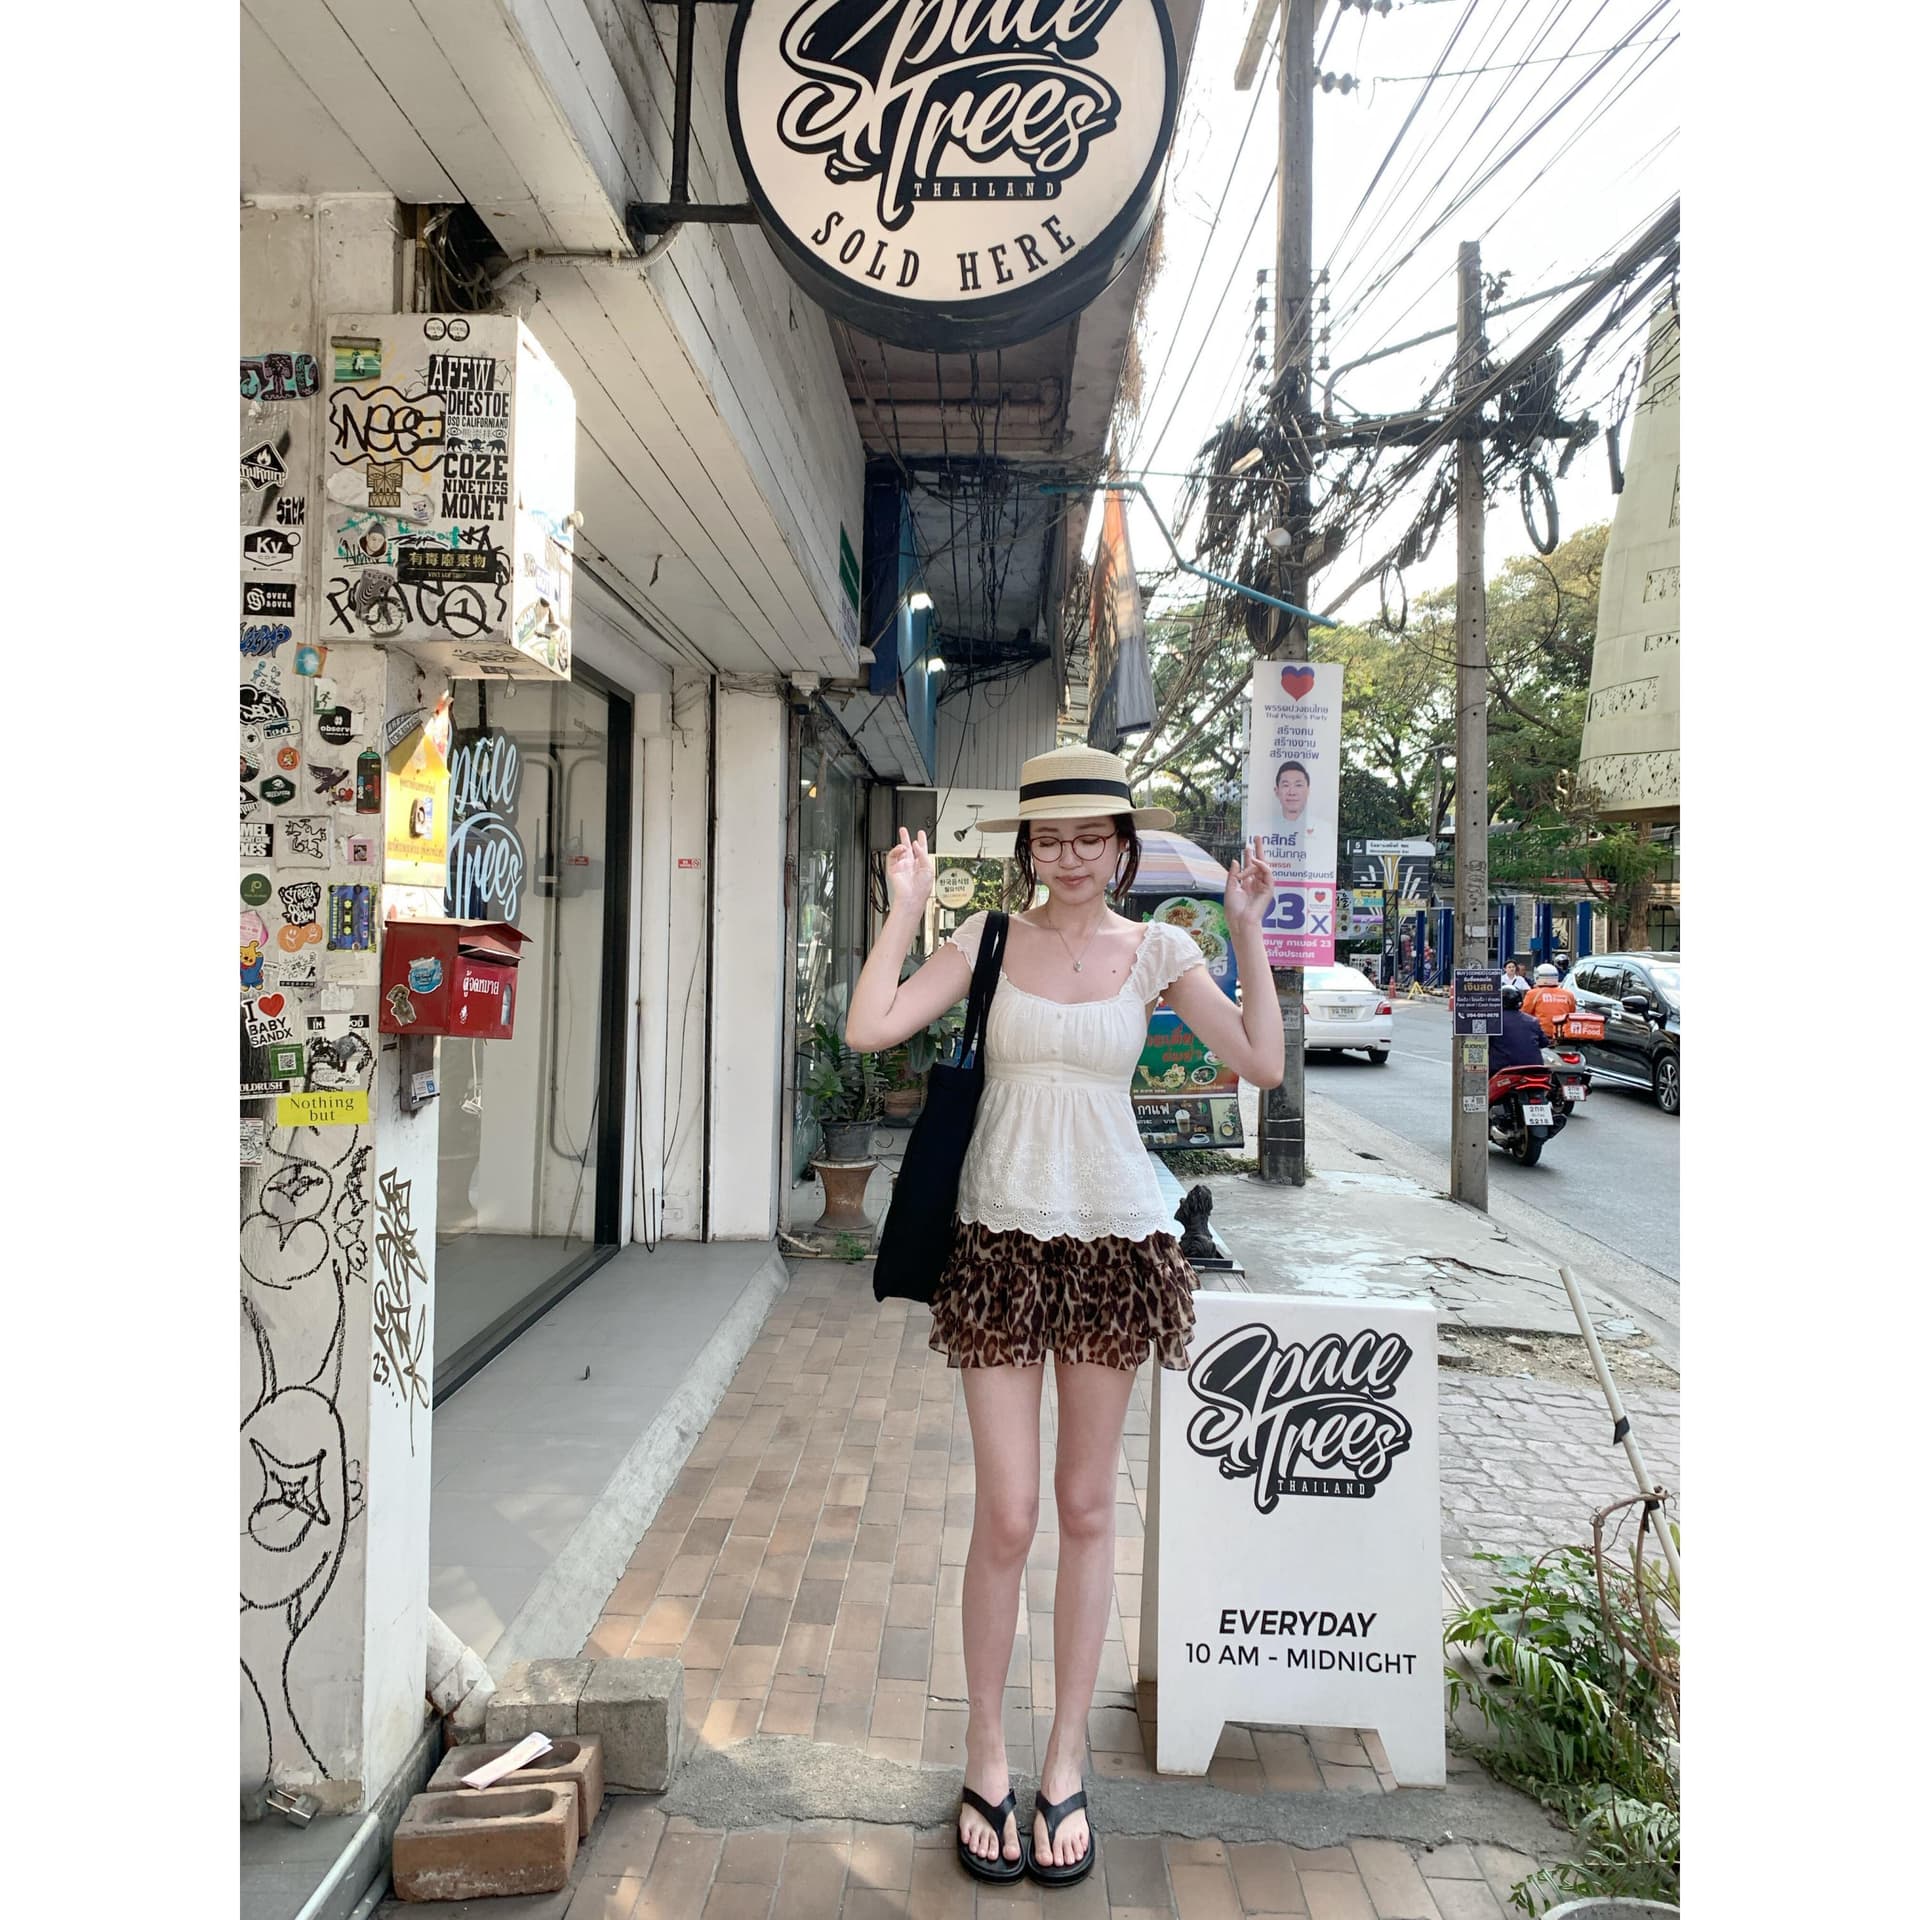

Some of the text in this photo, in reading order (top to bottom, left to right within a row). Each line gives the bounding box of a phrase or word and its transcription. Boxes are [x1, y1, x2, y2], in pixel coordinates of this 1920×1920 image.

[872, 53, 1108, 216] Trees
[914, 182, 1056, 198] THAILAND
[811, 211, 1075, 291] SOLD HERE
[443, 453, 509, 480] COZE
[443, 479, 509, 495] NINETIES
[441, 493, 508, 521] MONET
[266, 592, 288, 600] OVER
[1276, 724, 1314, 736] สร้างคน
[1273, 736, 1317, 748] สร้างงาน
[1269, 748, 1320, 760] สร้างอาชีพ
[446, 735, 519, 828] pace
[1248, 832, 1299, 846] เกสิทธิ์
[1261, 893, 1306, 930] 23
[463, 969, 500, 998] ตู้จดหมาย
[1463, 982, 1494, 991] เงินสด
[243, 1000, 258, 1023] I
[248, 1017, 287, 1036] BABY
[250, 1027, 294, 1046] SANDX
[290, 1096, 354, 1111] Nothing
[1137, 1103, 1170, 1115] กาแฟ
[309, 1110, 336, 1121] but
[1190, 1325, 1407, 1465] Space
[1253, 1392, 1405, 1508] Trees
[1277, 1479, 1366, 1496] THAILAND
[1219, 1609, 1377, 1638] EVERYDAY
[1186, 1643, 1211, 1664] 10
[1218, 1645, 1259, 1666] AM
[1287, 1648, 1417, 1675] MIDNIGHT
